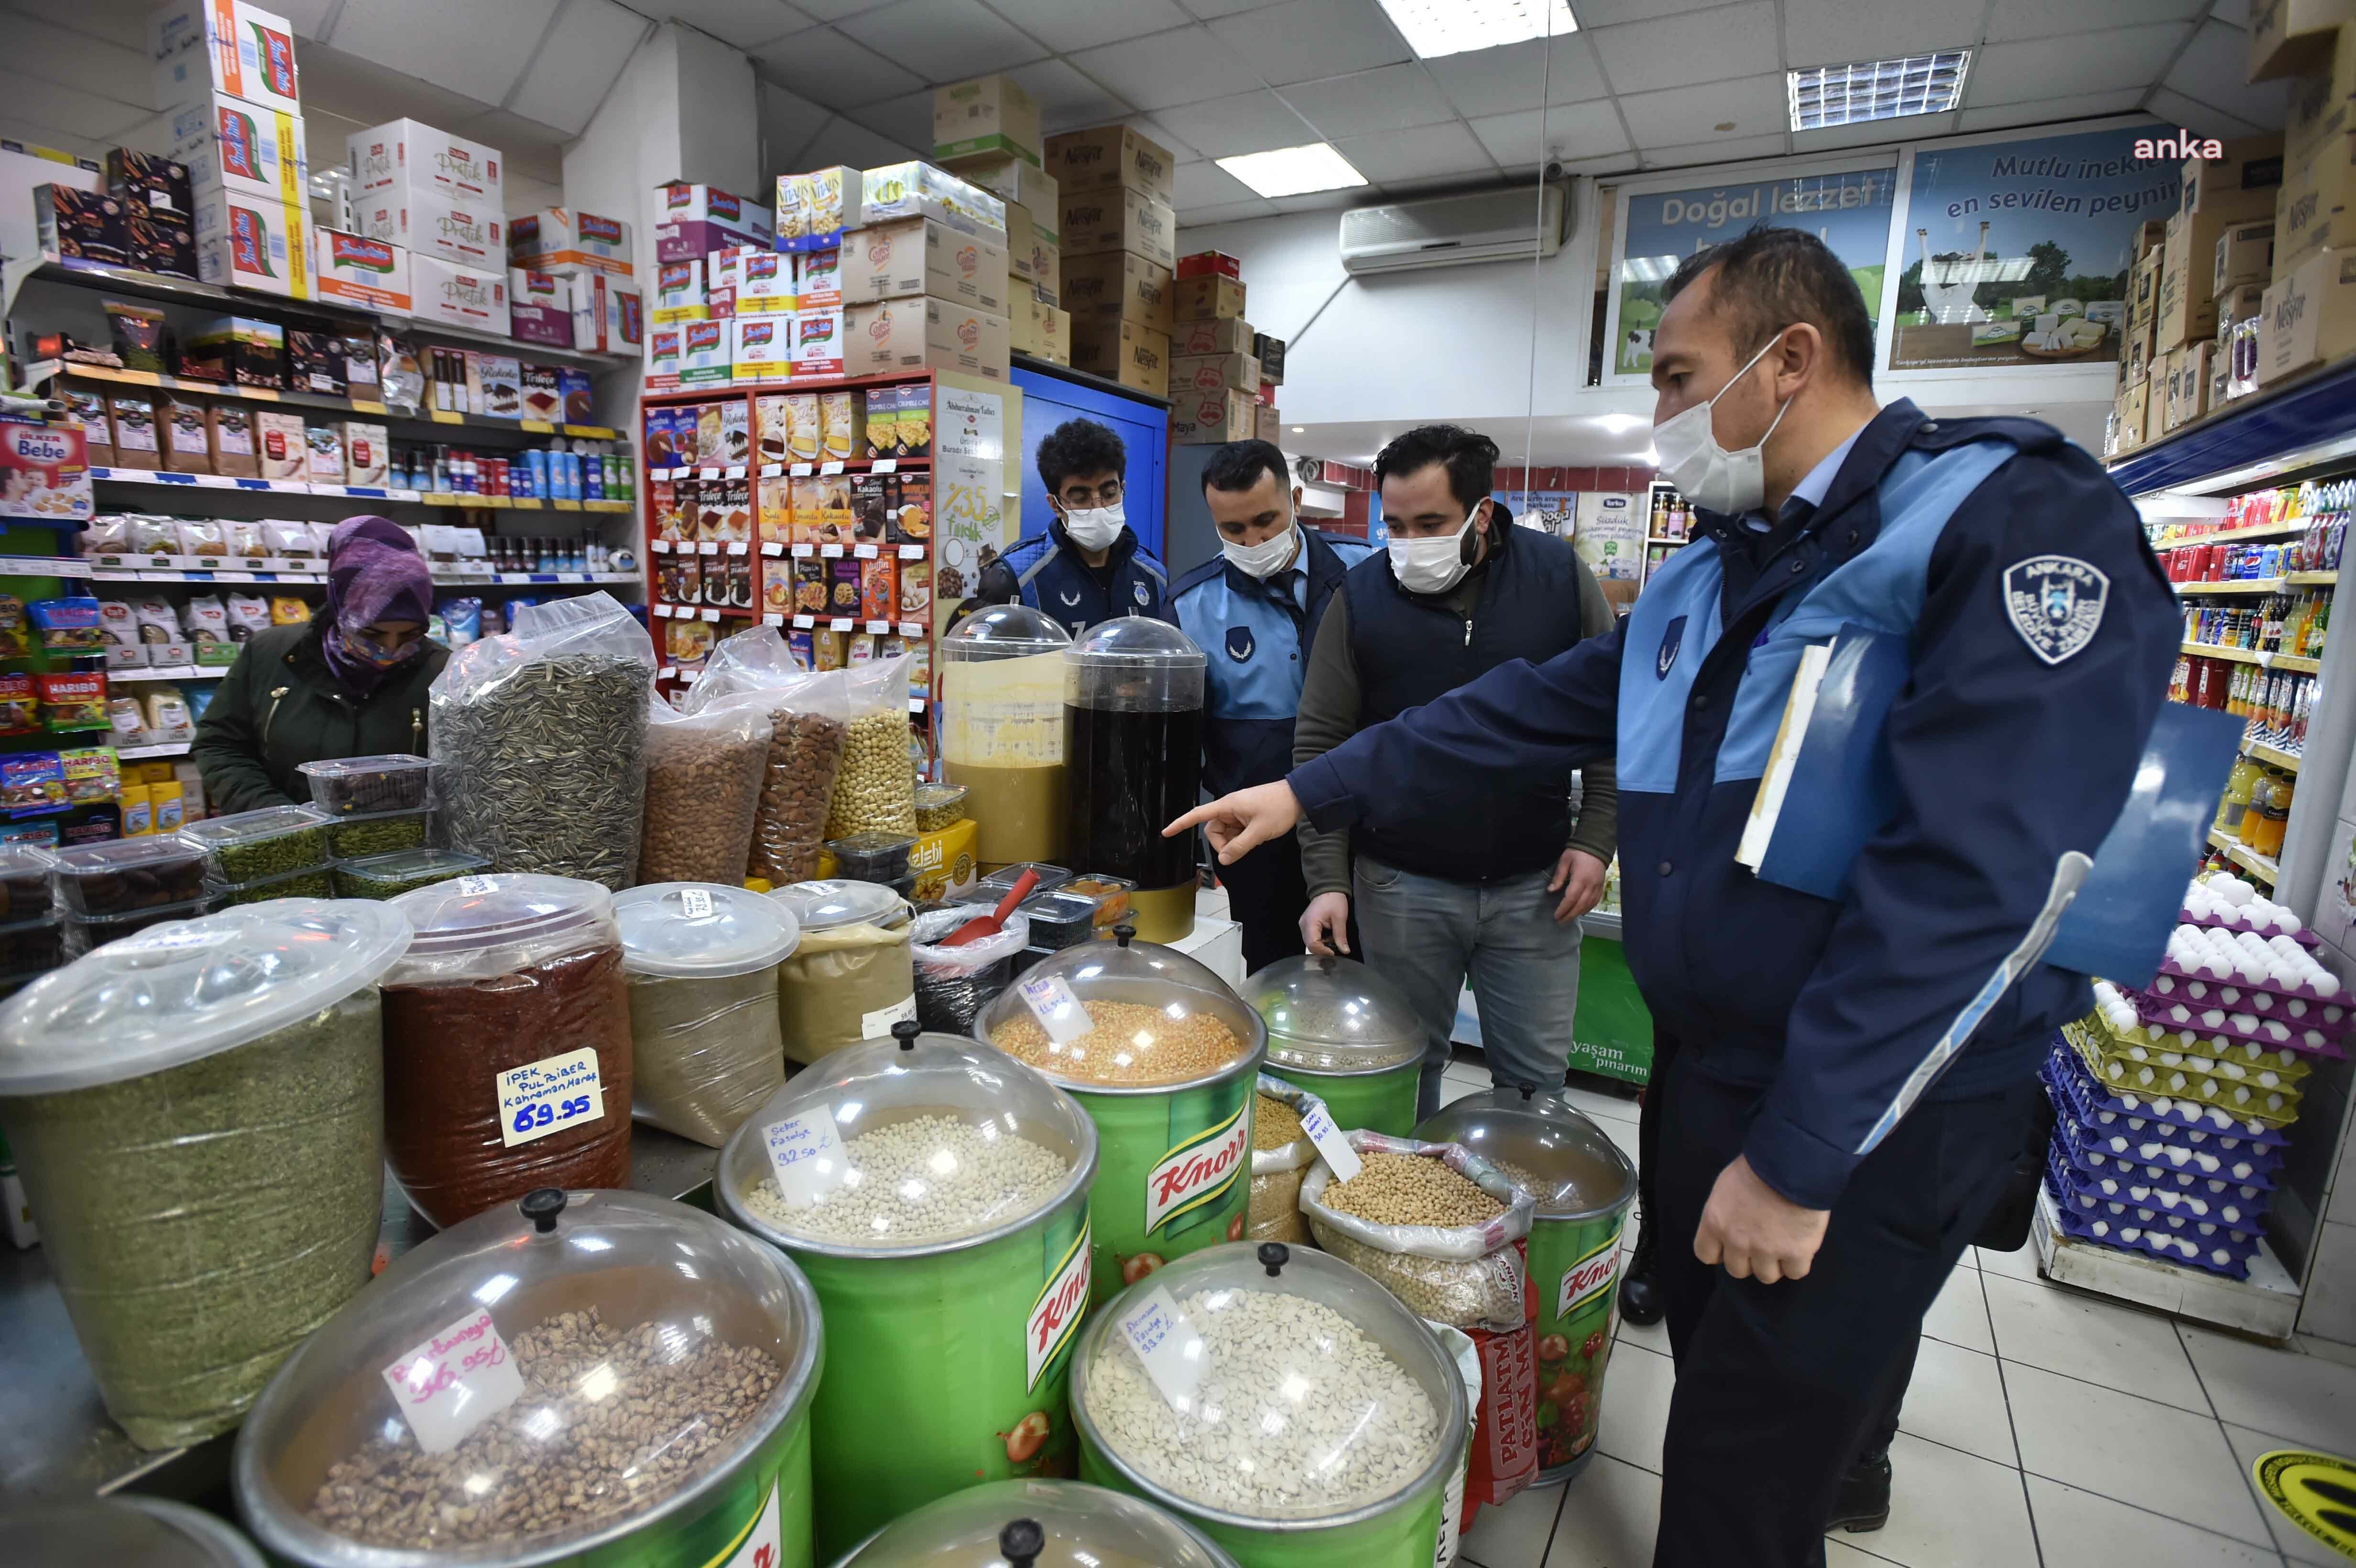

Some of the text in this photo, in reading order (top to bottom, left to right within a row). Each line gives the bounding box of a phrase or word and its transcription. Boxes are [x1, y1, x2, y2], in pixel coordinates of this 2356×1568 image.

[1992, 154, 2071, 179] Mutlu
[1662, 178, 1876, 228] Doğal lezzet
[1947, 196, 1979, 219] en
[1989, 189, 2081, 213] sevilen
[480, 366, 518, 379] Rokoko
[19, 431, 61, 442] ÜLKER
[1172, 422, 1196, 435] Maya
[19, 440, 65, 458] Bebe
[943, 483, 987, 522] %35
[864, 558, 889, 572] Muffin
[2026, 563, 2094, 587] ANKARA
[49, 683, 98, 694] HARIBO
[64, 756, 110, 766] HARIBO
[1571, 1040, 1623, 1061] yaşam
[1596, 1057, 1647, 1077] pınarım
[518, 1081, 544, 1092] PUL
[513, 1095, 590, 1132] 69.95
[1152, 1129, 1247, 1207] Knorr
[1493, 1253, 1519, 1300] CANBAK
[1493, 1338, 1517, 1465] PATLATM
